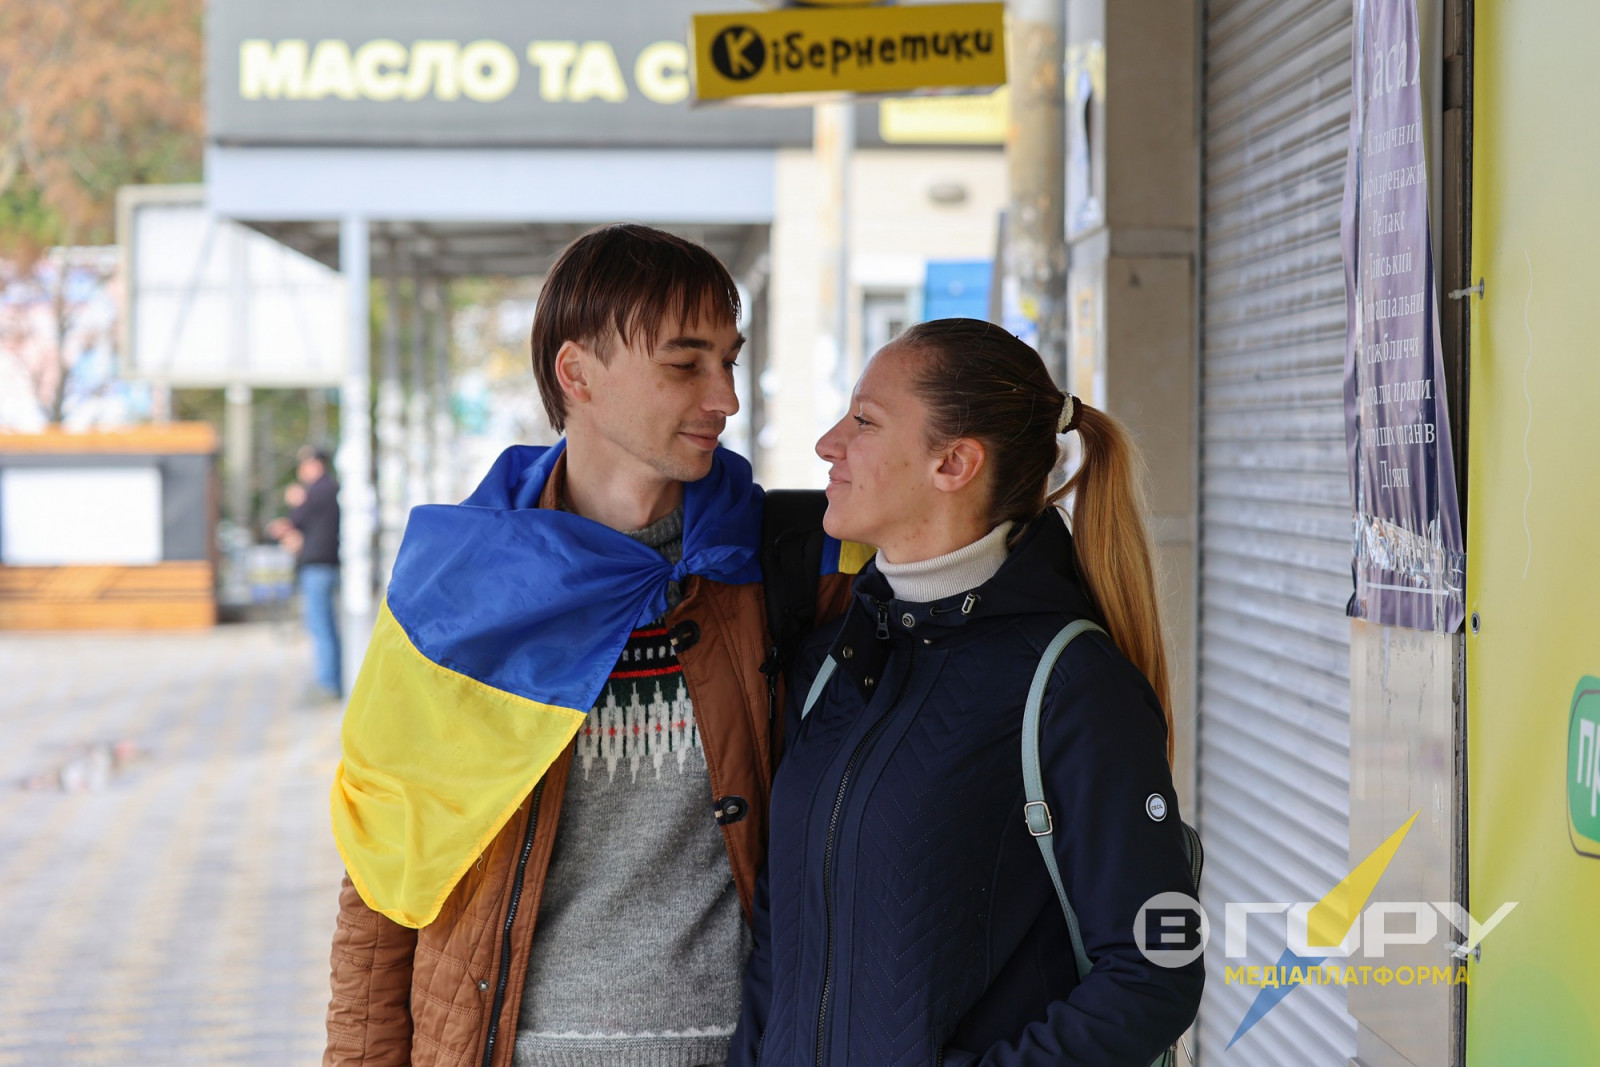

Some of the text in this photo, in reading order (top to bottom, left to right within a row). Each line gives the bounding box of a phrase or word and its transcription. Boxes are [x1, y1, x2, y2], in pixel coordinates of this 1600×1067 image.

[239, 39, 690, 103] МАСЛО ТА С
[711, 24, 995, 82] Кібернетики
[1369, 37, 1421, 101] аса
